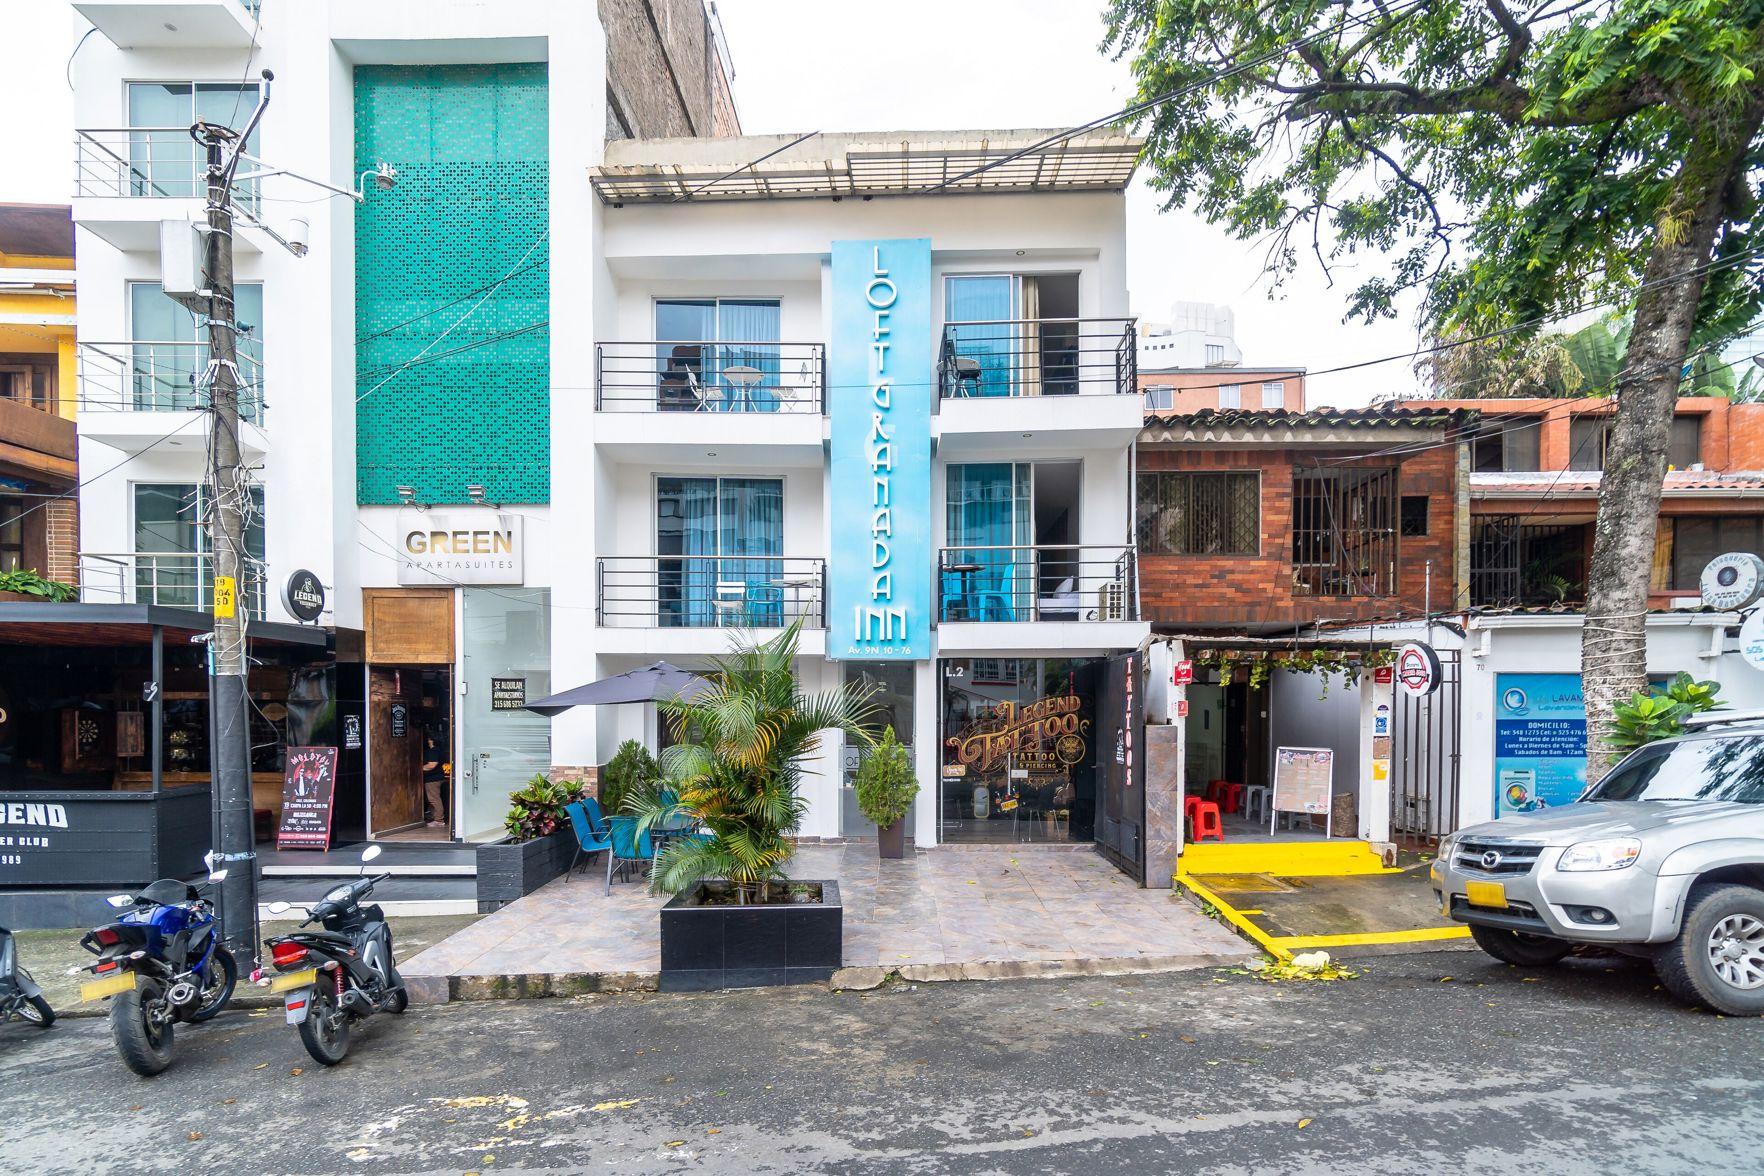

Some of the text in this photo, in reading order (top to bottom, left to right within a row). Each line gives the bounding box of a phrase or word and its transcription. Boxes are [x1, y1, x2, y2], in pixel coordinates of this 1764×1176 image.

[865, 245, 898, 602] LOFT GRANADA
[405, 530, 513, 554] GREEN
[294, 590, 322, 605] LEGEND
[854, 605, 907, 641] INN
[848, 646, 862, 654] Av.
[865, 646, 879, 654] 9N
[884, 646, 893, 654] 10
[901, 646, 911, 655] 76
[945, 666, 964, 677] L.2
[501, 681, 523, 690] ALQUILAN
[1552, 694, 1584, 702] LAVAM
[993, 694, 1082, 727] LEGEND
[1125, 656, 1133, 786] TATTOOS
[945, 713, 1079, 774] TATTOO
[1013, 752, 1056, 761] TATTOO
[18, 837, 49, 847] CLUB
